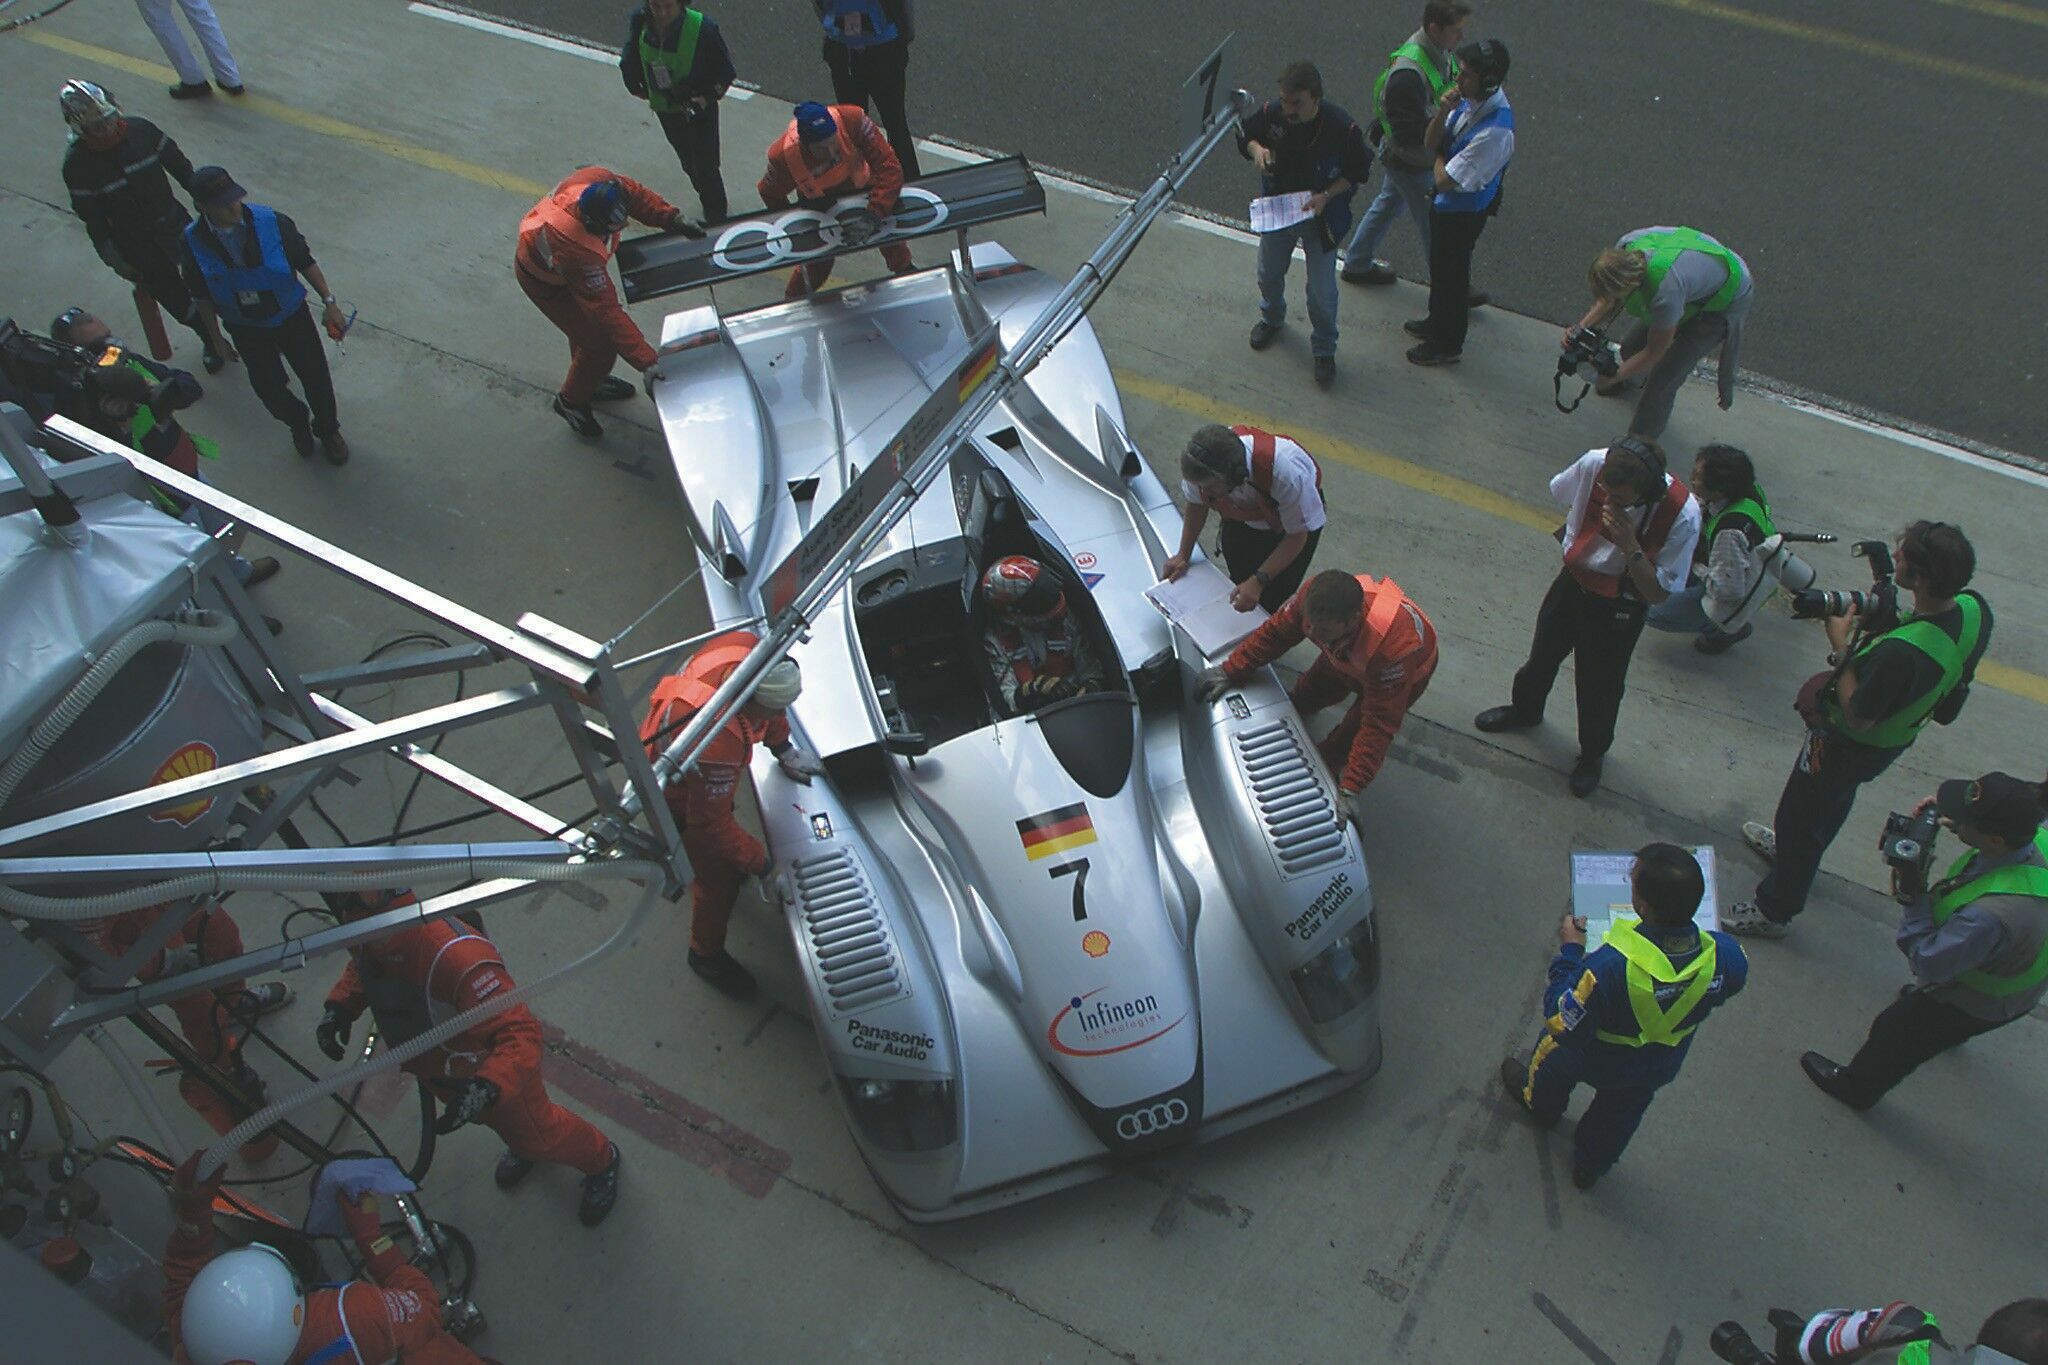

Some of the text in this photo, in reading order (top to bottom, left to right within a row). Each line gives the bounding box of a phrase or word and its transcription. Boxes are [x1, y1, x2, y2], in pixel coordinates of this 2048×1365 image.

[1199, 52, 1222, 130] 7
[1048, 857, 1090, 922] 7
[1284, 872, 1349, 937] Panasonic
[1299, 886, 1354, 941] Car Audio
[847, 1018, 935, 1049] Panasonic
[1076, 994, 1158, 1032] Infineon
[1084, 1012, 1162, 1041] technologies
[852, 1035, 927, 1061] Car Audio
